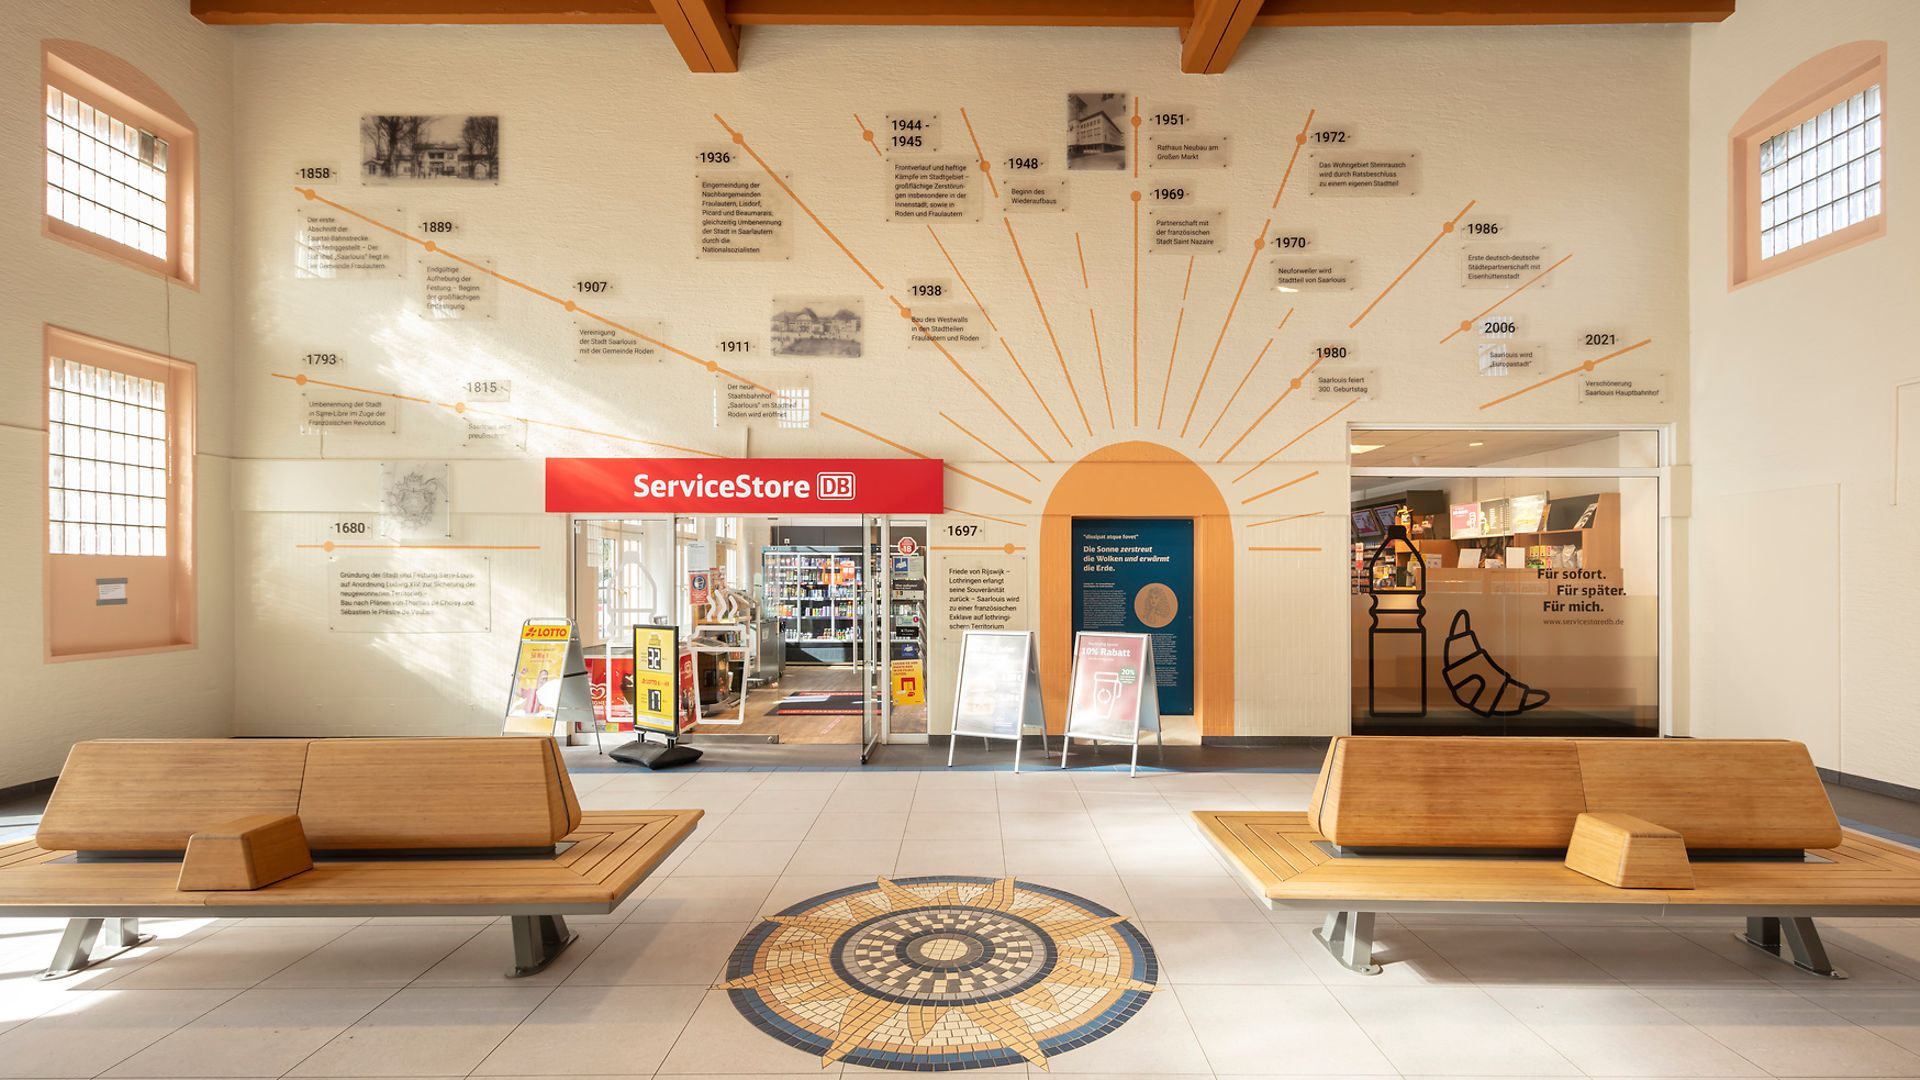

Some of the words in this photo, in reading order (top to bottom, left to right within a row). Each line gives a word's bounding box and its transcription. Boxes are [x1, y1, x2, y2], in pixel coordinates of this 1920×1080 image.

[1154, 114, 1184, 125] 1951
[892, 120, 922, 131] 1944
[892, 136, 922, 147] 1945
[1315, 132, 1346, 143] 1972
[700, 152, 730, 163] 1936
[1008, 158, 1038, 169] 1948
[300, 168, 330, 179] 1858
[1154, 189, 1184, 200] 1969
[422, 222, 452, 233] 1889
[1468, 223, 1498, 234] 1986
[1276, 237, 1306, 248] 1970
[576, 281, 607, 293] 1907
[912, 286, 942, 296] 1938
[1484, 322, 1516, 333] 2006
[1586, 334, 1616, 345] 2021
[720, 341, 749, 352] 1911
[1316, 347, 1347, 358] 1980
[306, 354, 336, 365] 1793
[466, 382, 497, 393] 1815
[634, 473, 810, 498] ServiceStore
[820, 474, 852, 498] DB
[335, 522, 365, 534] 1680
[948, 525, 978, 536] 1697
[1538, 568, 1558, 579] Für
[1562, 568, 1606, 580] sofort.
[1556, 585, 1578, 596] Für
[1581, 585, 1627, 598] später.
[1543, 601, 1565, 612] Für
[1569, 601, 1604, 612] mich.
[537, 628, 567, 637] LOTTO
[1082, 647, 1098, 656] 10%
[1101, 647, 1131, 657] Rabatt
[648, 648, 661, 669] 32
[652, 690, 661, 712] 17
